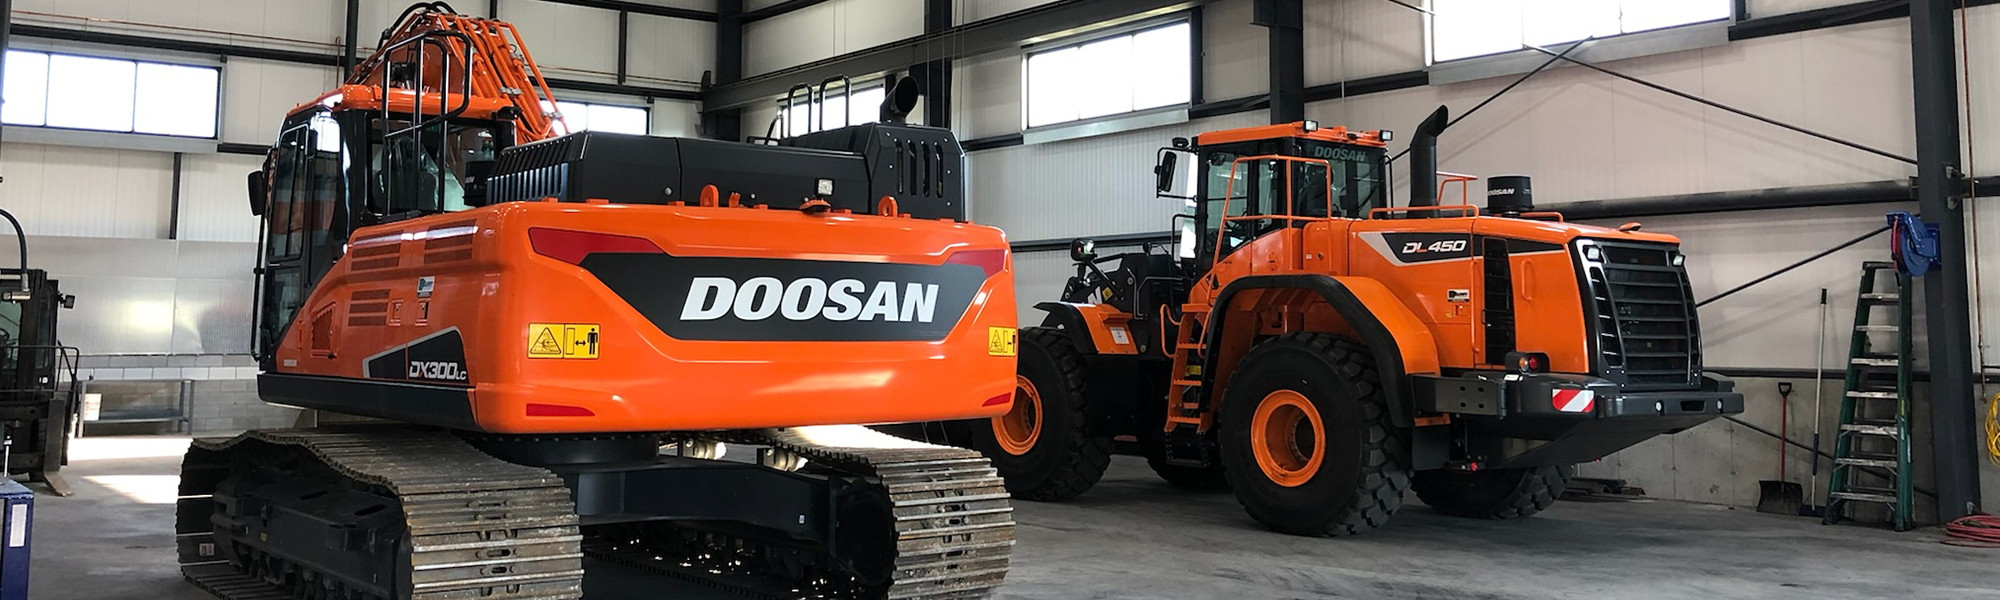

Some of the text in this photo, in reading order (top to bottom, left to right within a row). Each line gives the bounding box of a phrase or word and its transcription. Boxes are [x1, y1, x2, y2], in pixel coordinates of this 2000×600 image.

[1314, 146, 1366, 162] DOOSAN
[1402, 240, 1467, 254] DL450
[679, 276, 940, 323] DOOSAN
